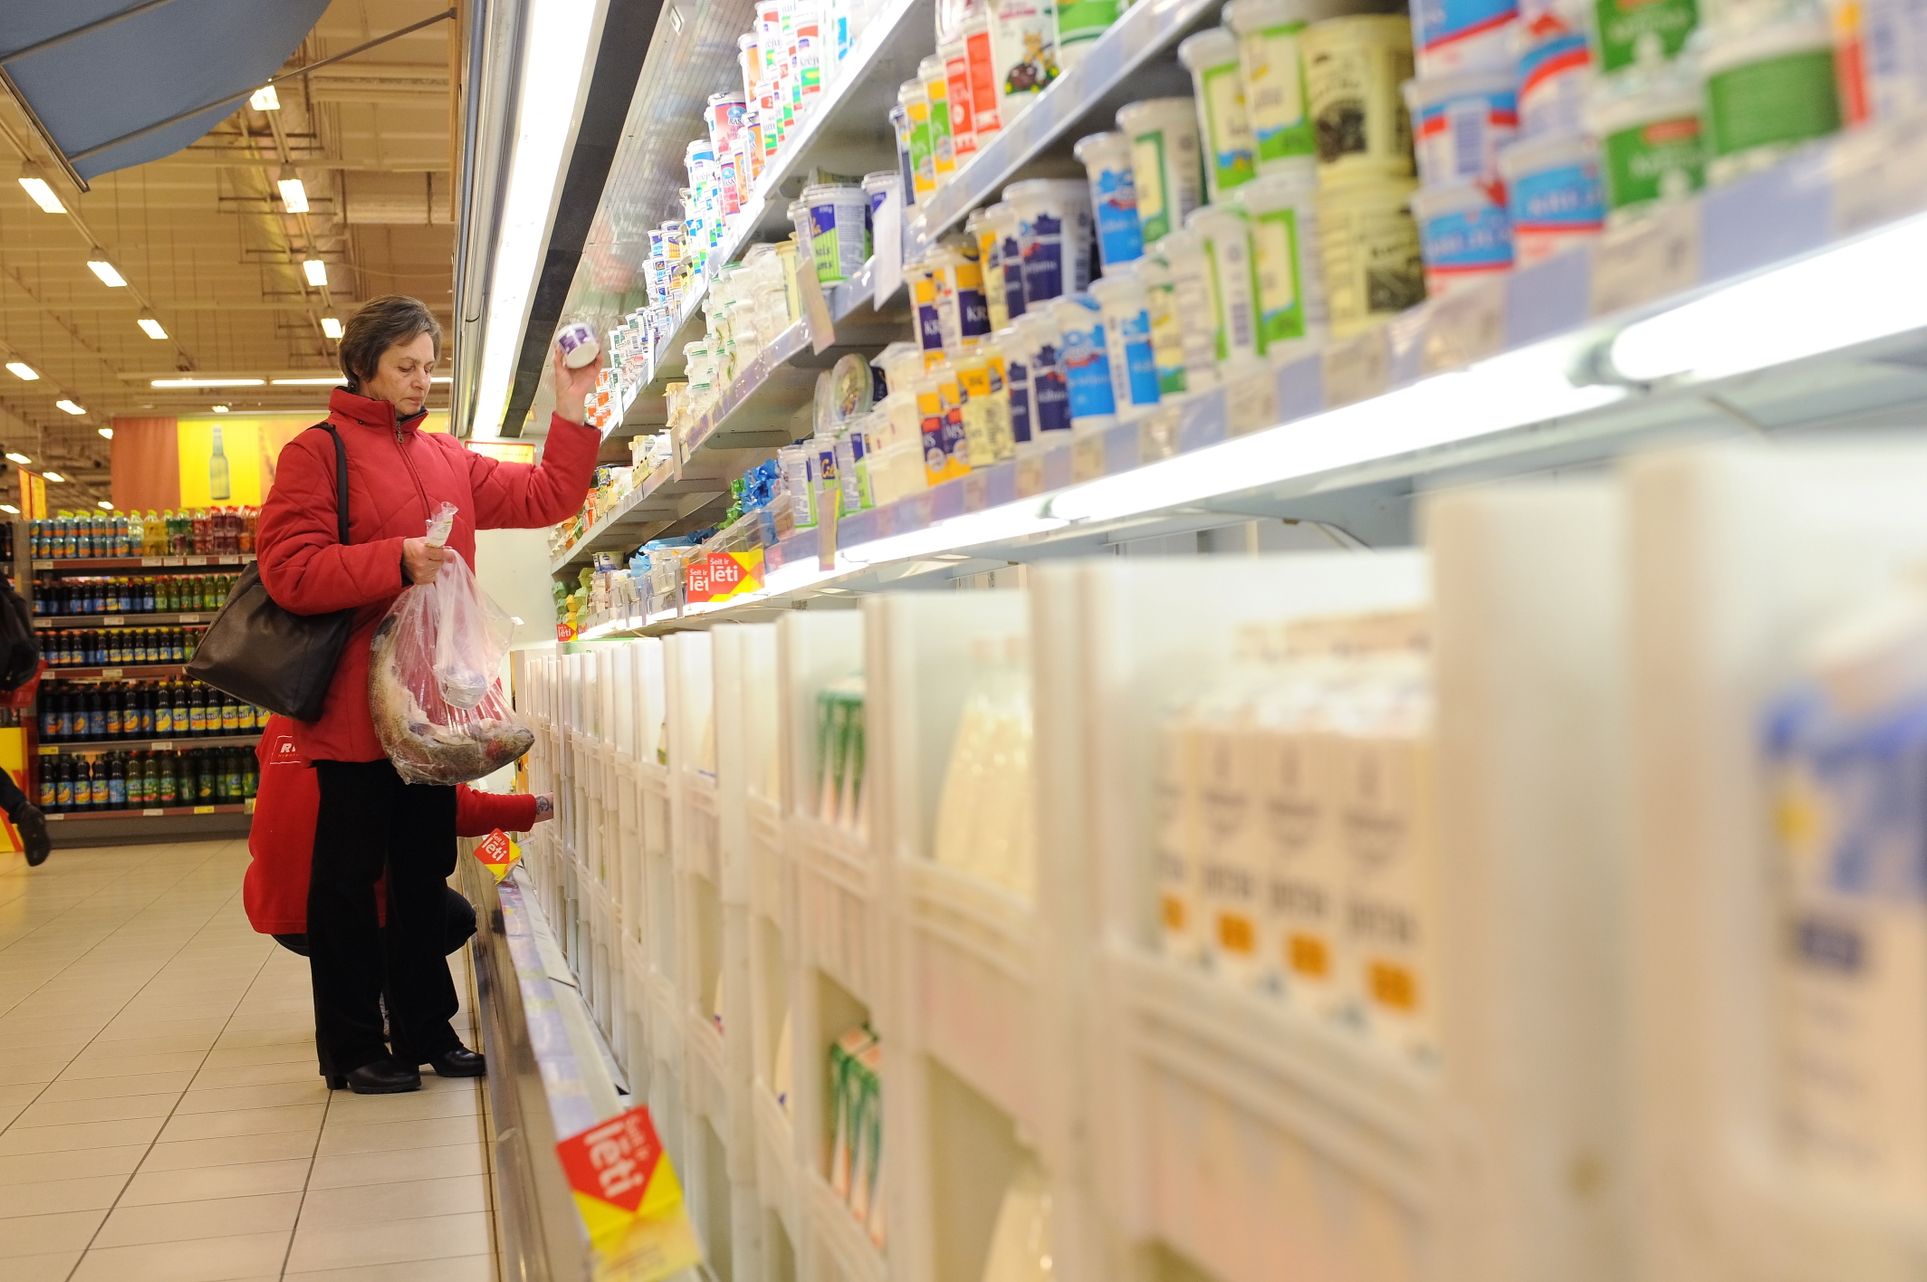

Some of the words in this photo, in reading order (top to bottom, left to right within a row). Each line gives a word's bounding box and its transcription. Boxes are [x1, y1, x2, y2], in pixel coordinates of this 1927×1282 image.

[689, 575, 709, 592] lēt
[710, 564, 739, 582] lēti
[482, 837, 507, 861] lēti
[584, 1119, 645, 1199] lēti
